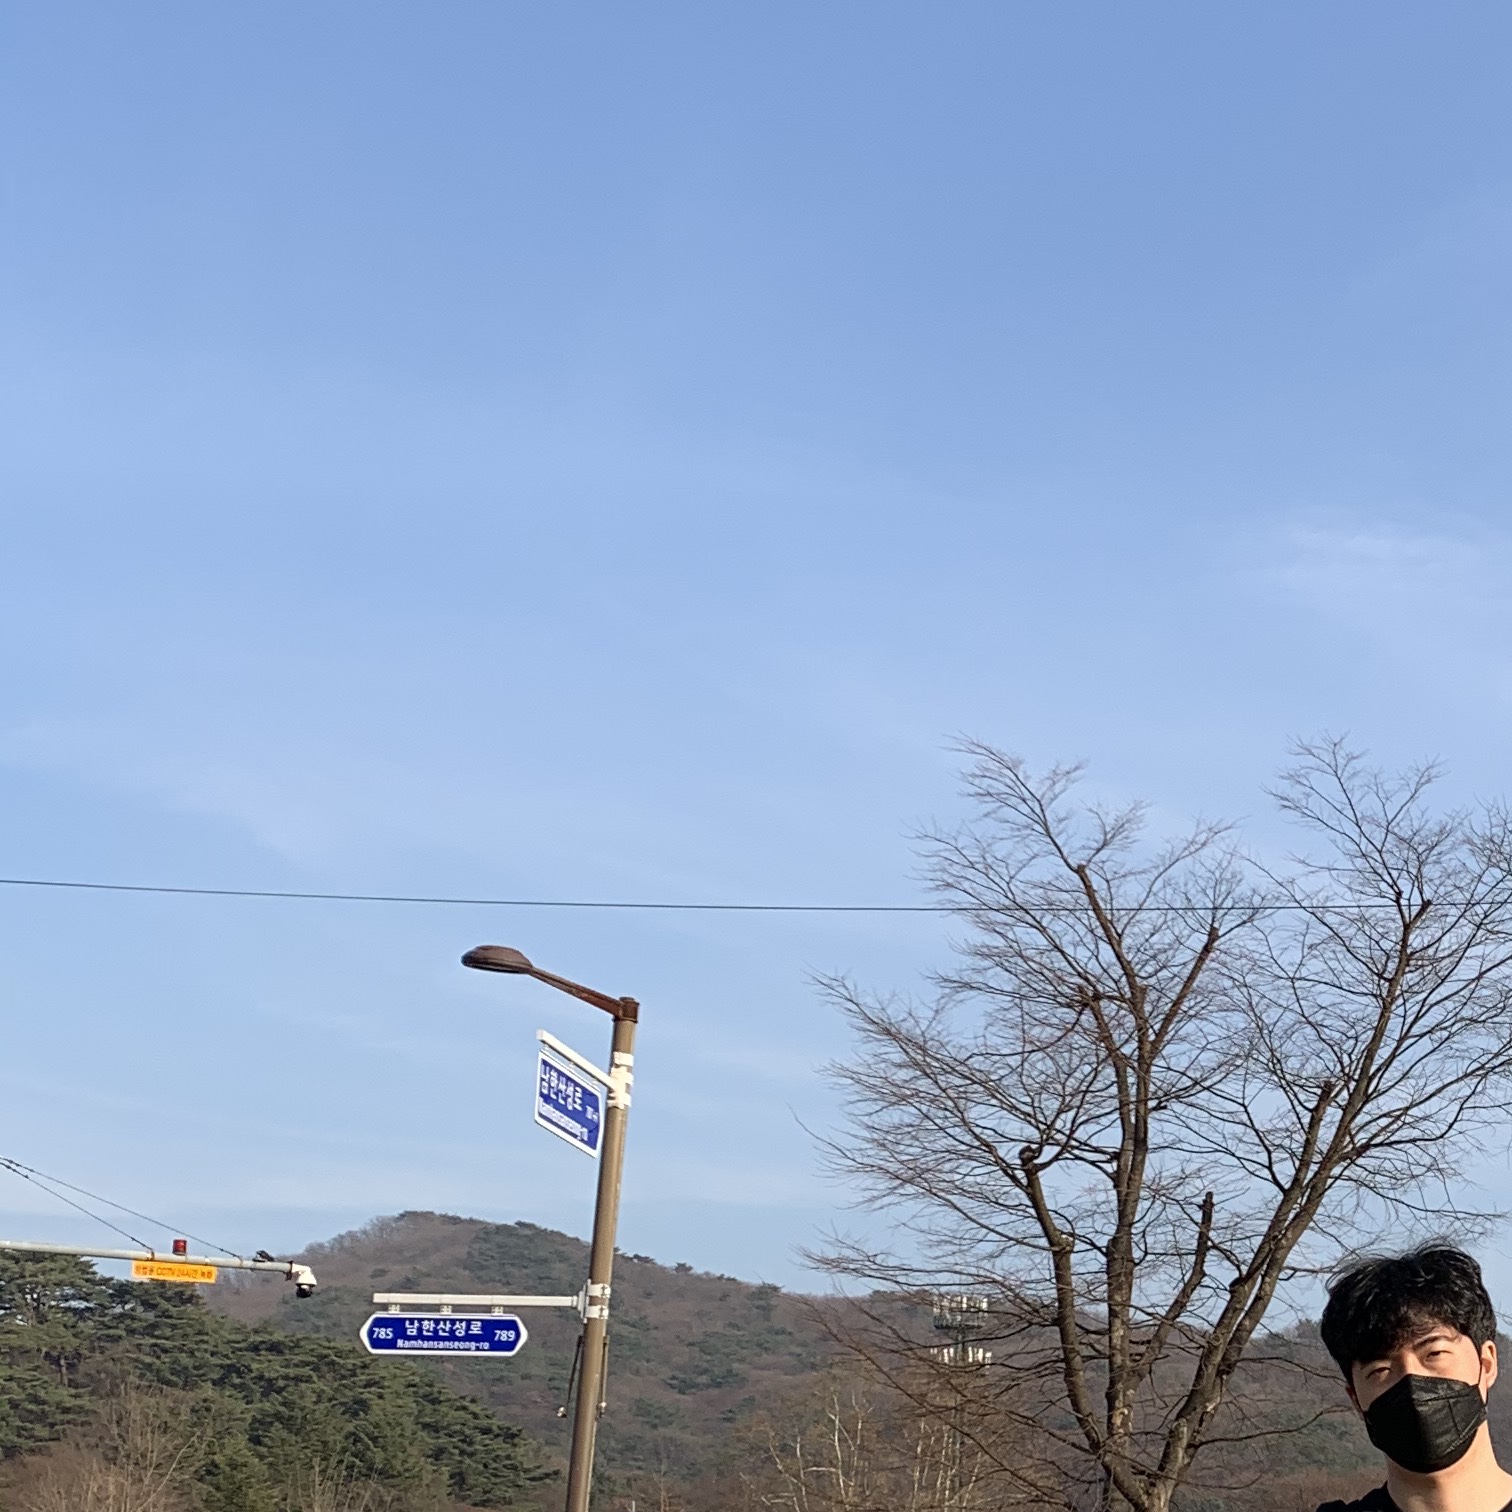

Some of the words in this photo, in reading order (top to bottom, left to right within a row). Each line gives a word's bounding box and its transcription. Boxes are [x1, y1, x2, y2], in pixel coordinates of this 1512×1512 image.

[540, 1064, 583, 1112] 남한산성로
[372, 1326, 394, 1340] 785
[404, 1319, 484, 1338] 남한산성로
[494, 1329, 516, 1342] 789
